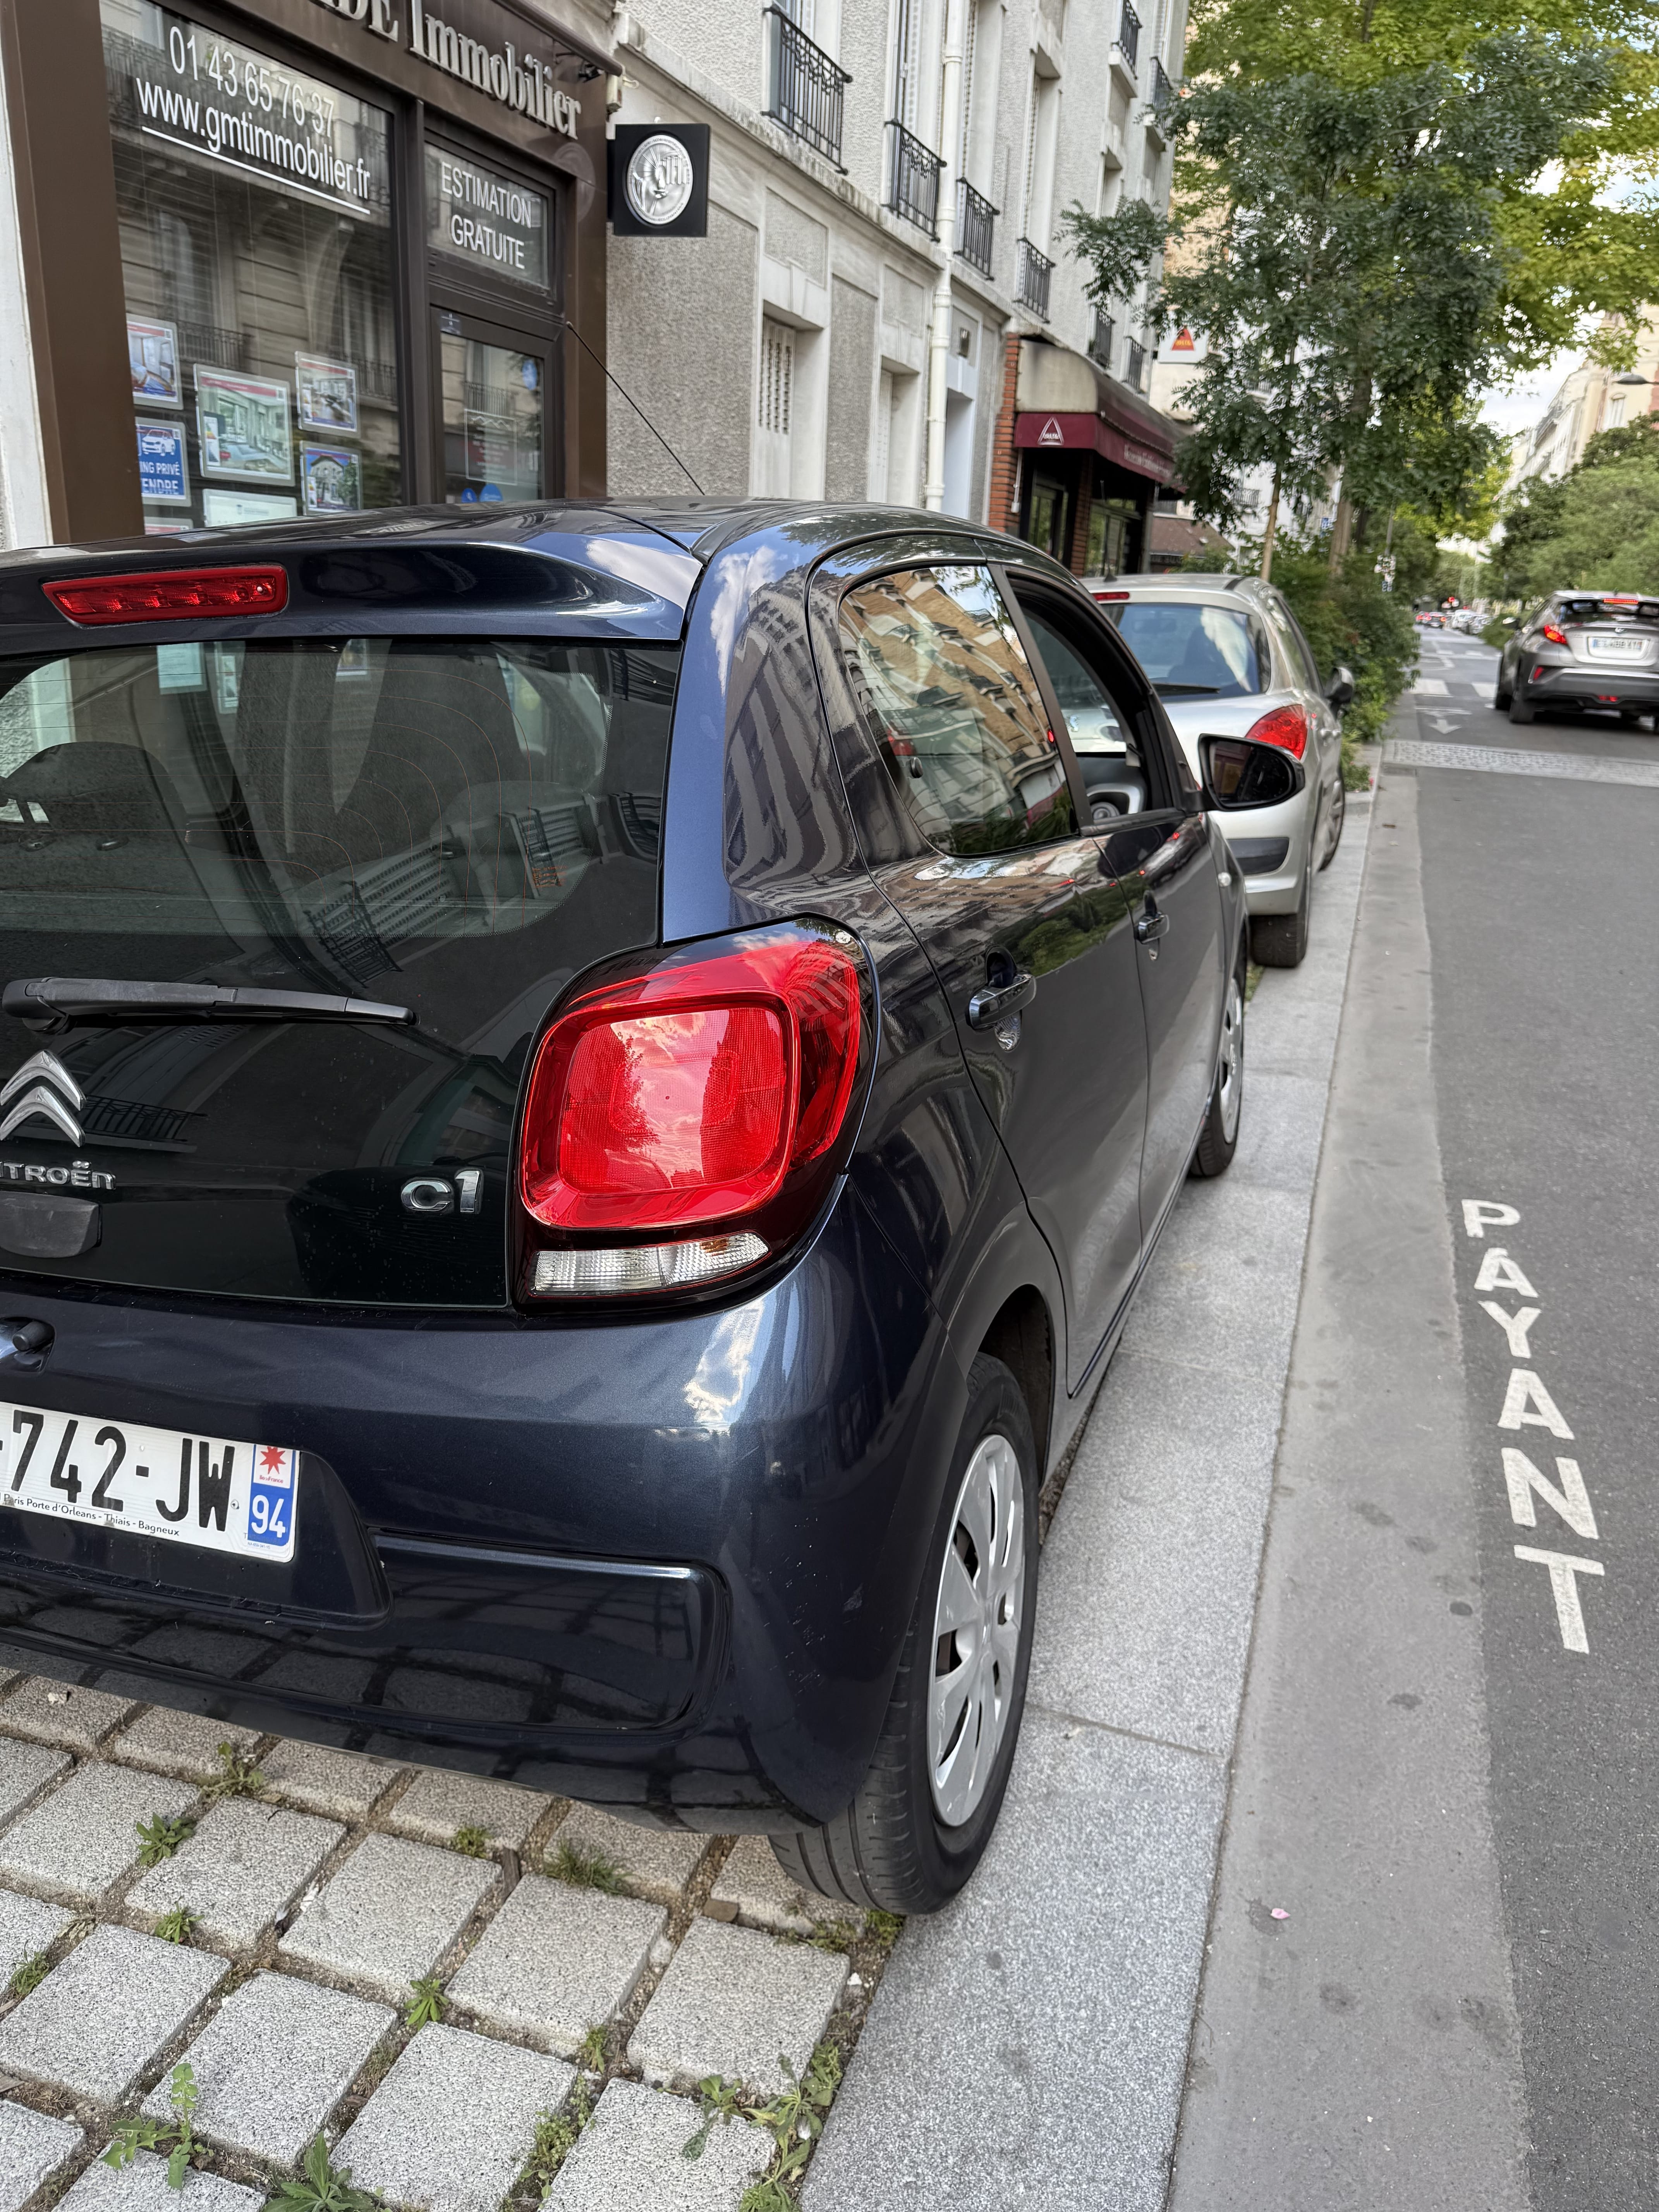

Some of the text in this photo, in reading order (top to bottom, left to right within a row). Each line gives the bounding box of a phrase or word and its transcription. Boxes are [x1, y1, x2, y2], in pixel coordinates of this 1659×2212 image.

[170, 26, 335, 137] 01 43 65 76 37
[410, 0, 581, 140] Immobilier
[136, 77, 370, 199] www.gmtimmobilier.fr
[441, 161, 531, 228] ESTIMATION
[451, 214, 525, 269] GRATUITE
[156, 462, 180, 476] PRIVÉ
[0, 1409, 235, 1532] 742-JW
[1462, 1199, 1605, 1654] PAYANT
[27, 1498, 50, 1510] Porte
[104, 1513, 131, 1527] Thiais
[139, 1520, 180, 1537] Bagneux
[251, 1494, 286, 1538] 94
